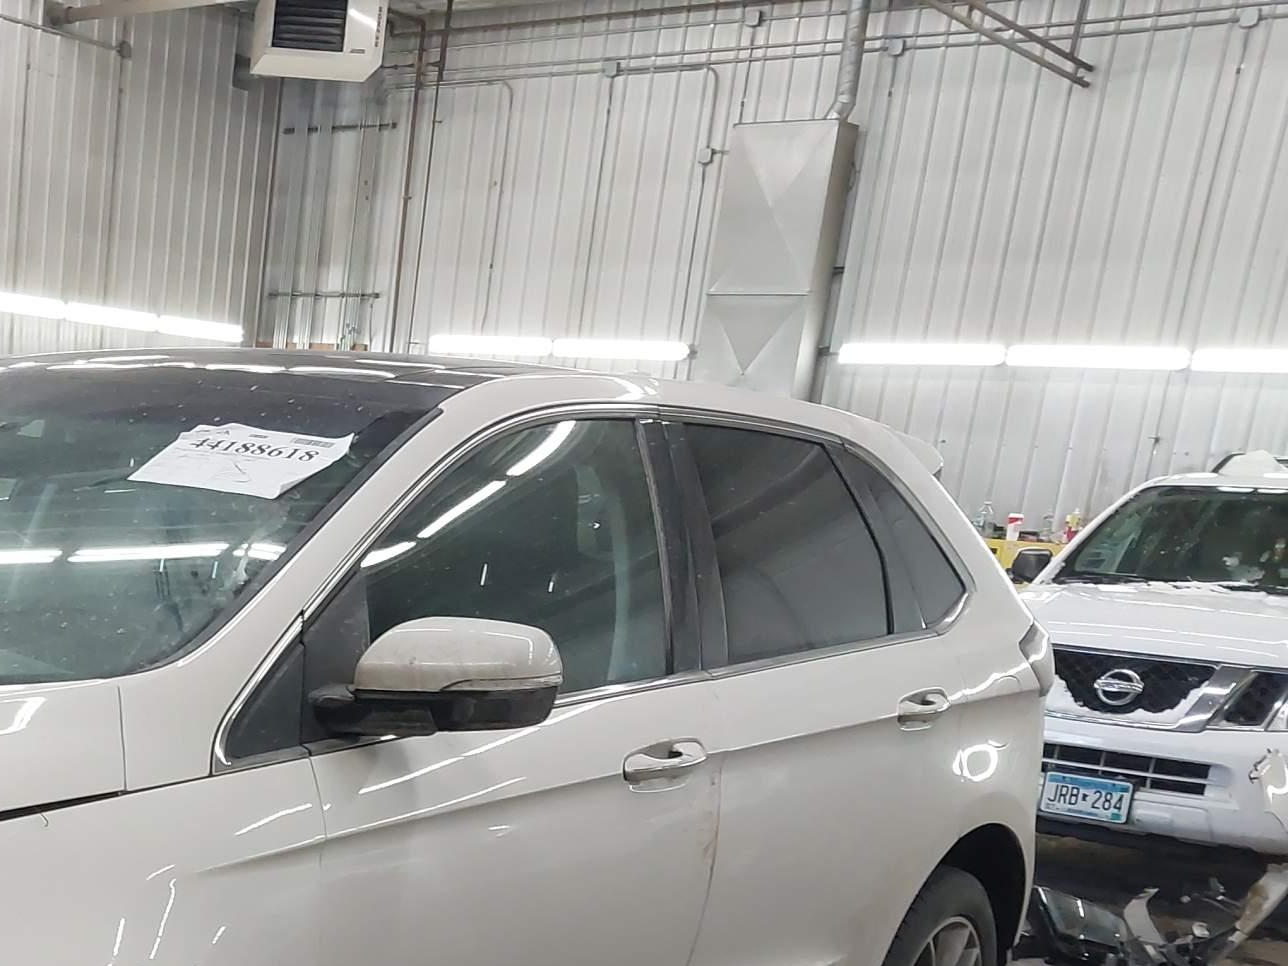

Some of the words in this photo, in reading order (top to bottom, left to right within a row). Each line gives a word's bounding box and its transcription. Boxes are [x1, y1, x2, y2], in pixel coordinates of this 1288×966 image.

[190, 437, 320, 462] 44188618
[1047, 784, 1080, 806] JRB
[1091, 790, 1124, 813] 284
